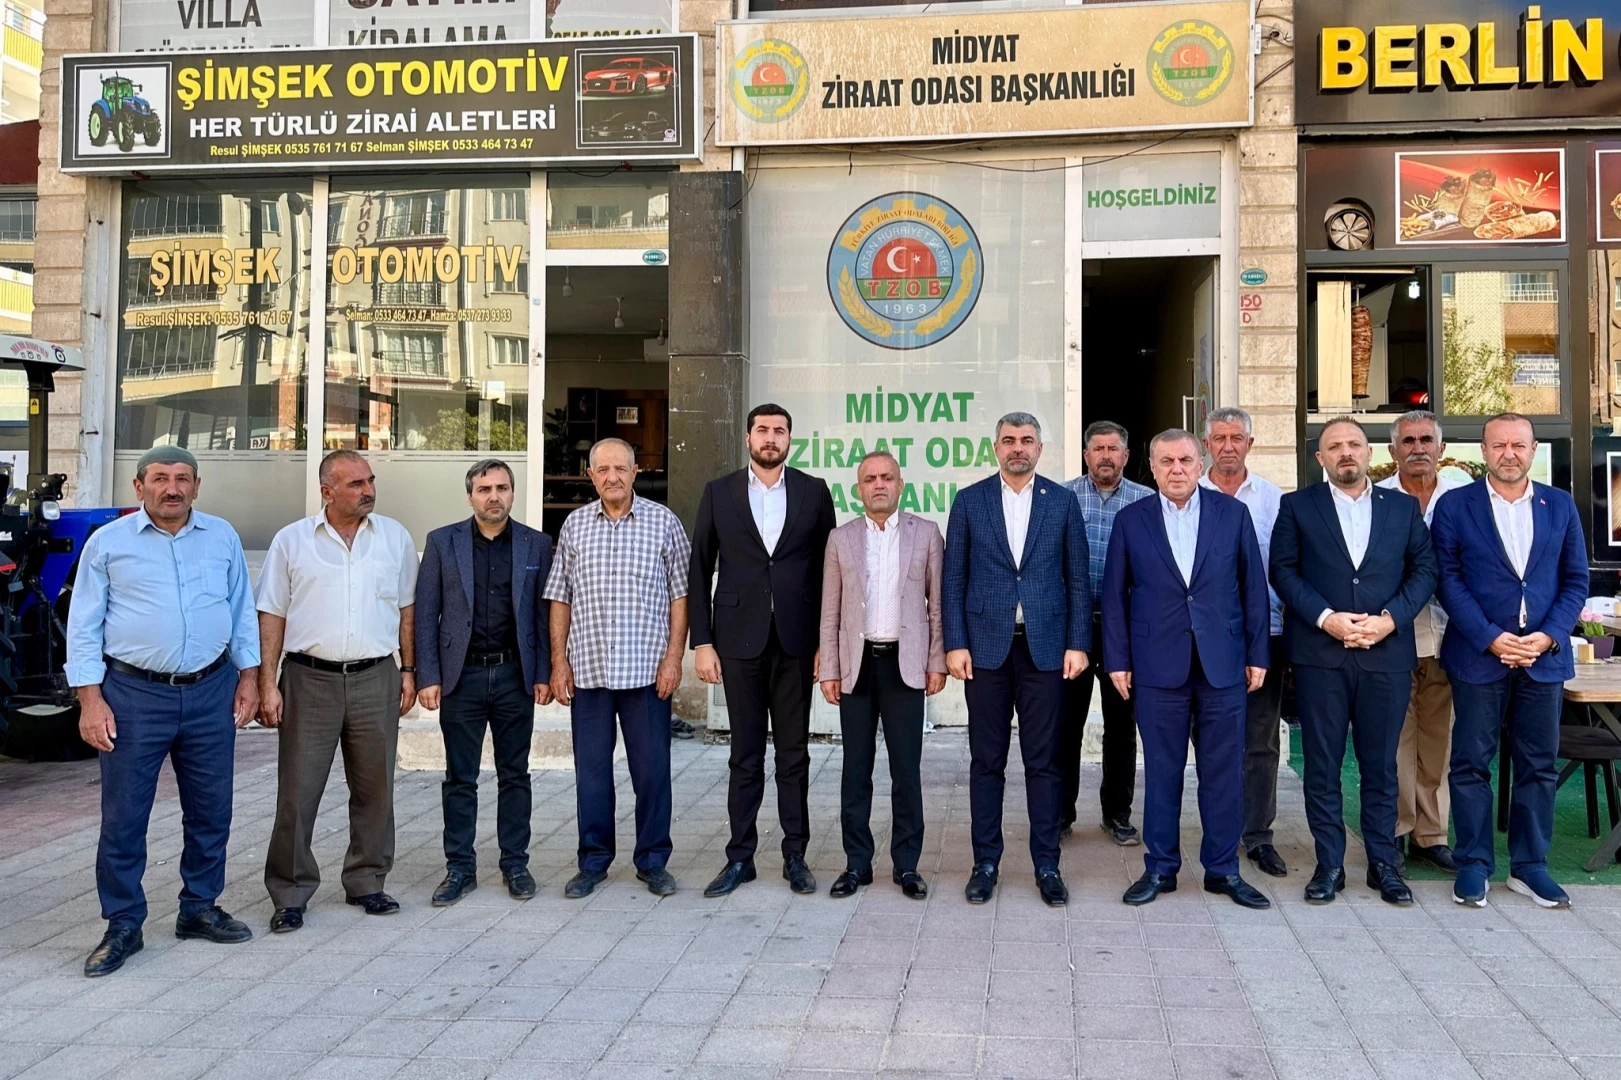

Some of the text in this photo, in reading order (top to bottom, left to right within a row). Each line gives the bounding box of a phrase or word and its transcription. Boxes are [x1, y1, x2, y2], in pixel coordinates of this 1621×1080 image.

[177, 0, 262, 29] VILLA
[932, 29, 1019, 65] MİDYAT
[1320, 5, 1604, 90] BERLİN
[176, 48, 569, 110] ŞİMŞEK OTOMOTİV
[821, 62, 1135, 108] ZİRAAT ODASI BAŞKANLIĞI
[189, 104, 556, 138] HER TÜRLÜ ZİRAİ ALETLERİ
[210, 138, 534, 158] Resul ŞİMŞEK 0535 761 71 67 Selman ŞİMŞEK 0533 464 73 47
[1087, 182, 1217, 210] HOŞGELDİNİZ
[150, 235, 523, 296] ŞİMŞEK OTOMOTİV
[860, 241, 879, 277] VATAN
[867, 280, 942, 298] TZOB
[135, 313, 166, 327] Resul
[213, 311, 240, 326] 0535
[242, 311, 260, 325] 761
[264, 311, 276, 325] 71
[279, 310, 293, 325] 67
[884, 303, 927, 314] 1963
[1242, 312, 1252, 324] D
[845, 385, 975, 423] MİDYAT
